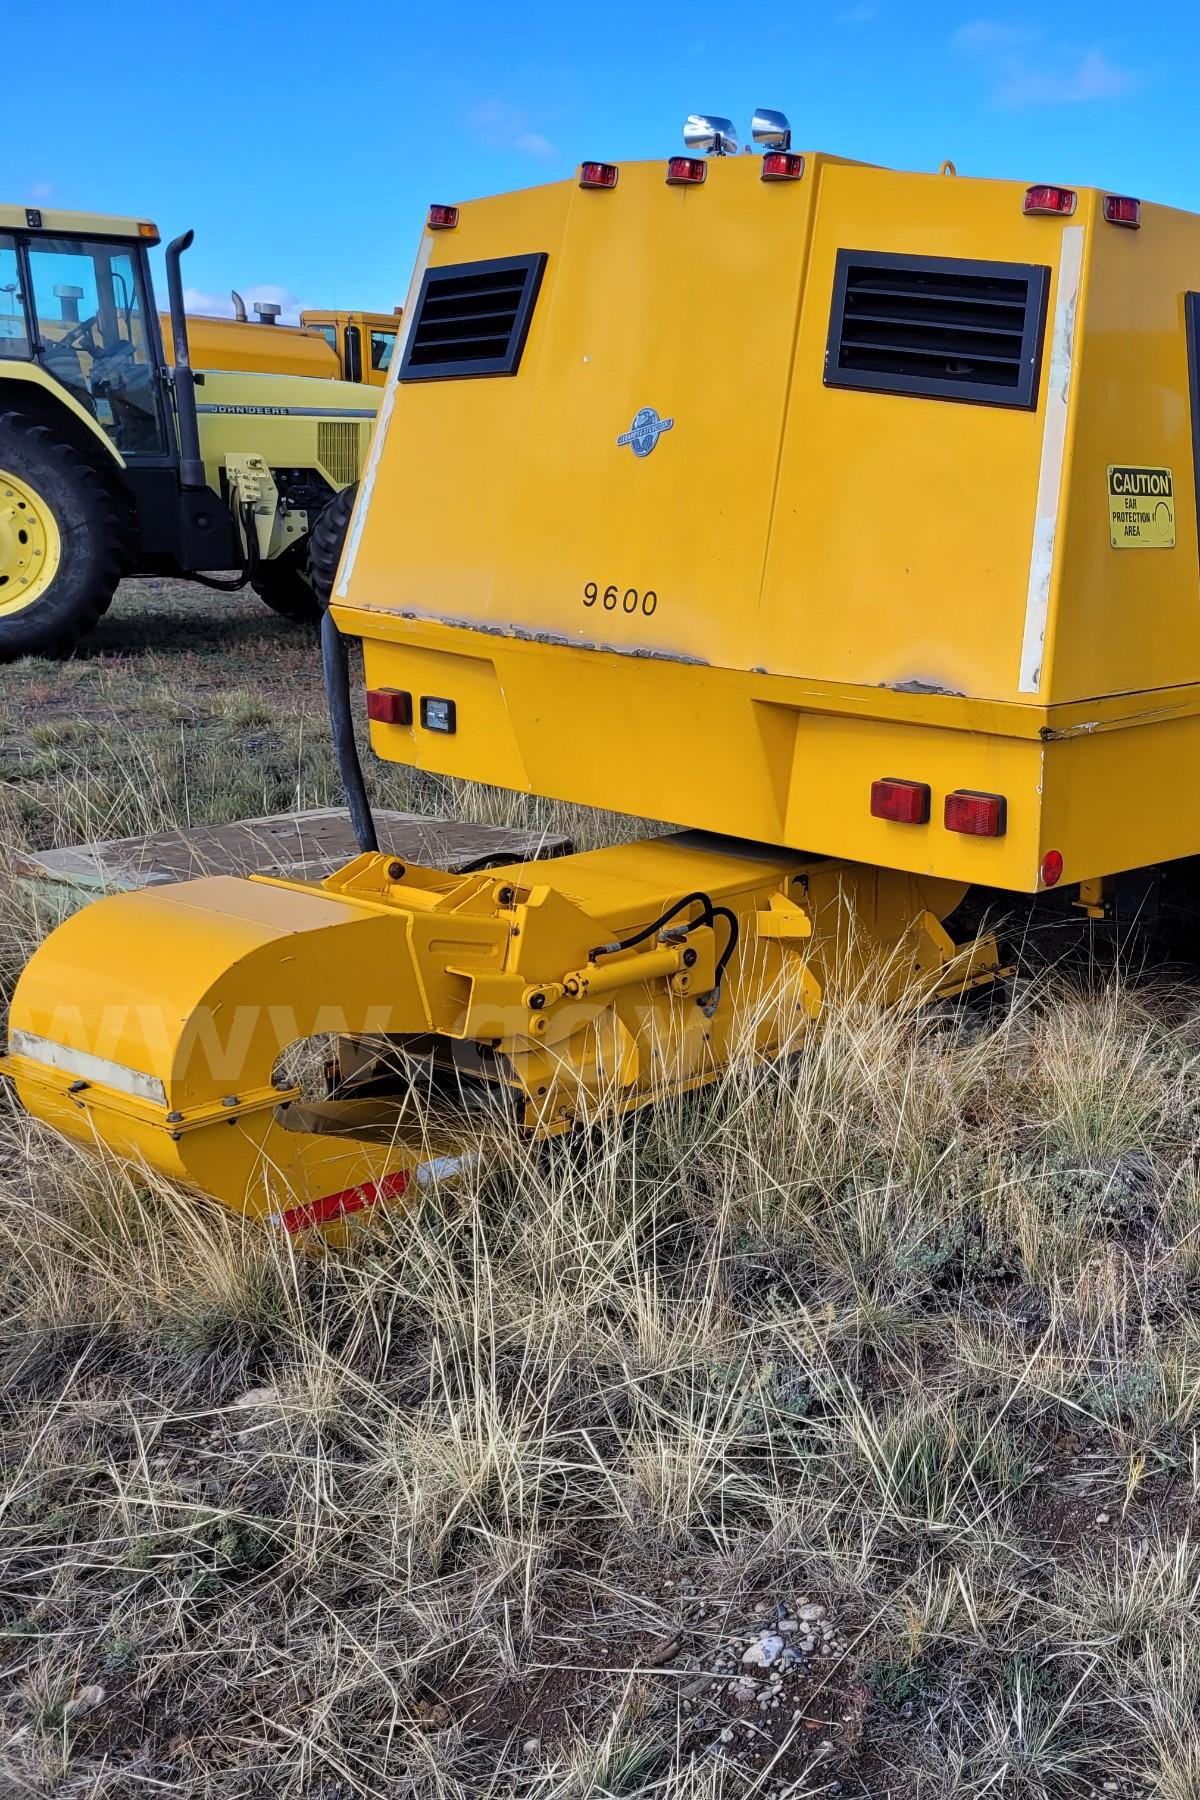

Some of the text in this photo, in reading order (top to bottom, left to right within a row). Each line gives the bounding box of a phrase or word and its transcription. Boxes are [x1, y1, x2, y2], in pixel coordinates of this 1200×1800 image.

[211, 405, 288, 415] JOHN DEERE
[1112, 472, 1170, 495] CAUTION
[1124, 498, 1137, 509] EAR
[1112, 511, 1151, 523] PROTECTION
[1124, 525, 1141, 536] AREA
[582, 582, 658, 616] 9600
